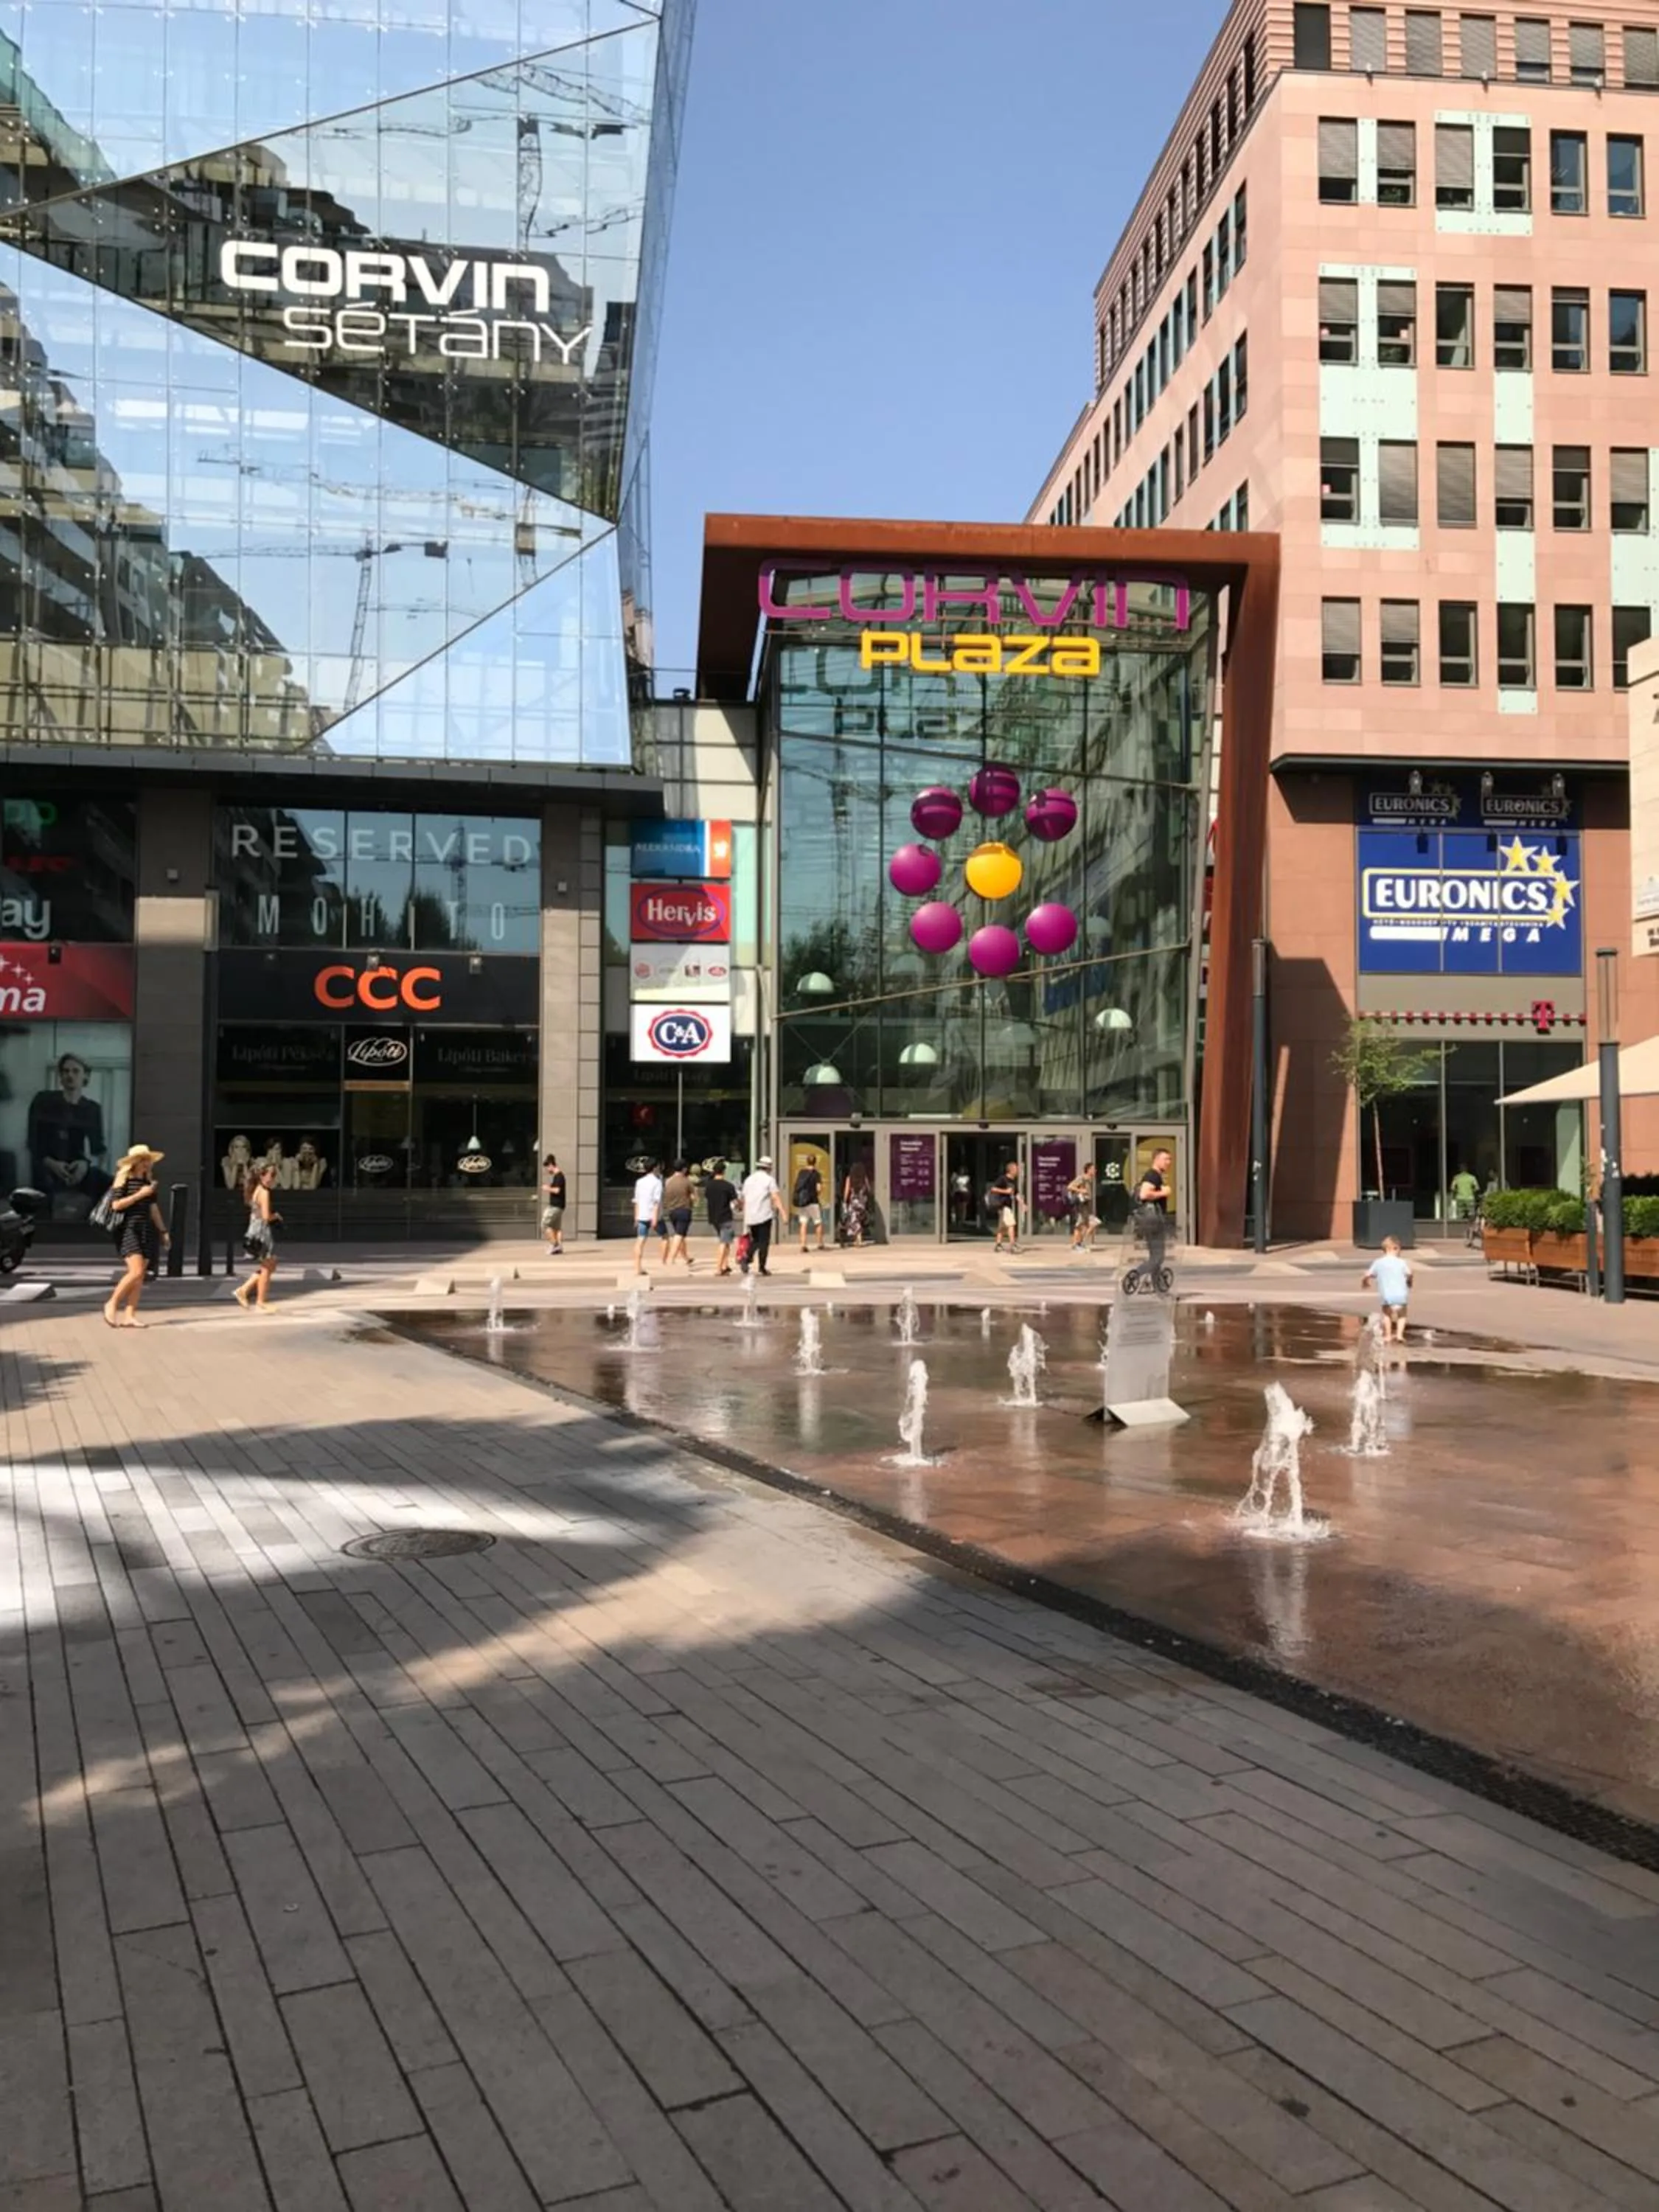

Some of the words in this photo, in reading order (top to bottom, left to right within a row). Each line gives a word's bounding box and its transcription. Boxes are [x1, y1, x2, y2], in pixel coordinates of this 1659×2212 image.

[1374, 797, 1450, 812] EURONICS
[1486, 799, 1559, 815] EURONICS
[232, 824, 532, 865] RESERVED
[1375, 878, 1548, 911] EURONICS
[647, 897, 717, 927] Hervis
[1451, 926, 1541, 943] MEGA
[314, 965, 442, 1010] CCC
[660, 1021, 702, 1044] C&A
